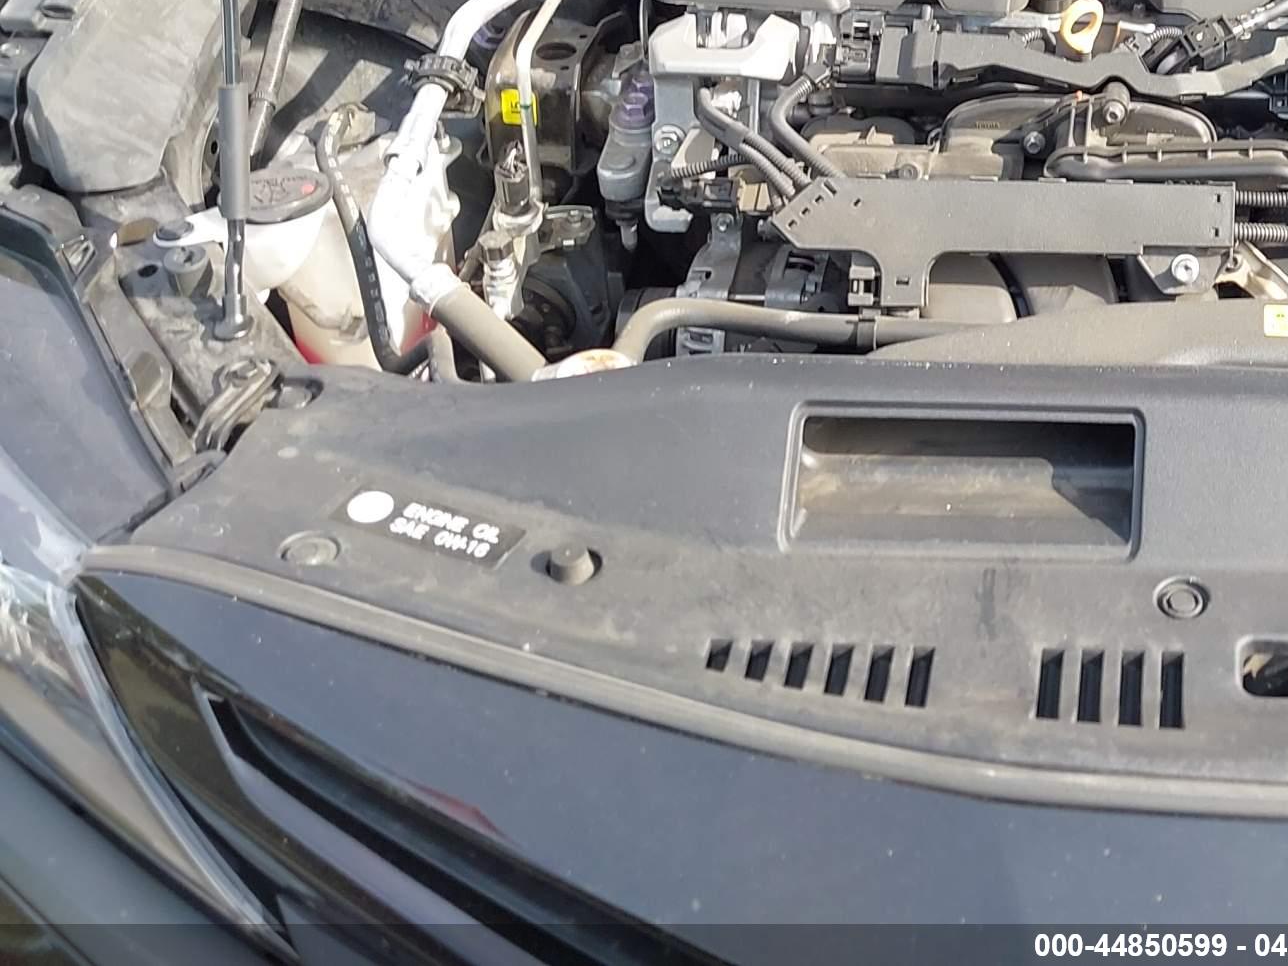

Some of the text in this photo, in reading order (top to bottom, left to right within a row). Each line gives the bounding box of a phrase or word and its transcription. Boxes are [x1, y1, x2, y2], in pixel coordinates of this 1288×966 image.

[389, 517, 431, 540] SAE
[402, 502, 501, 545] ENGINE OIL
